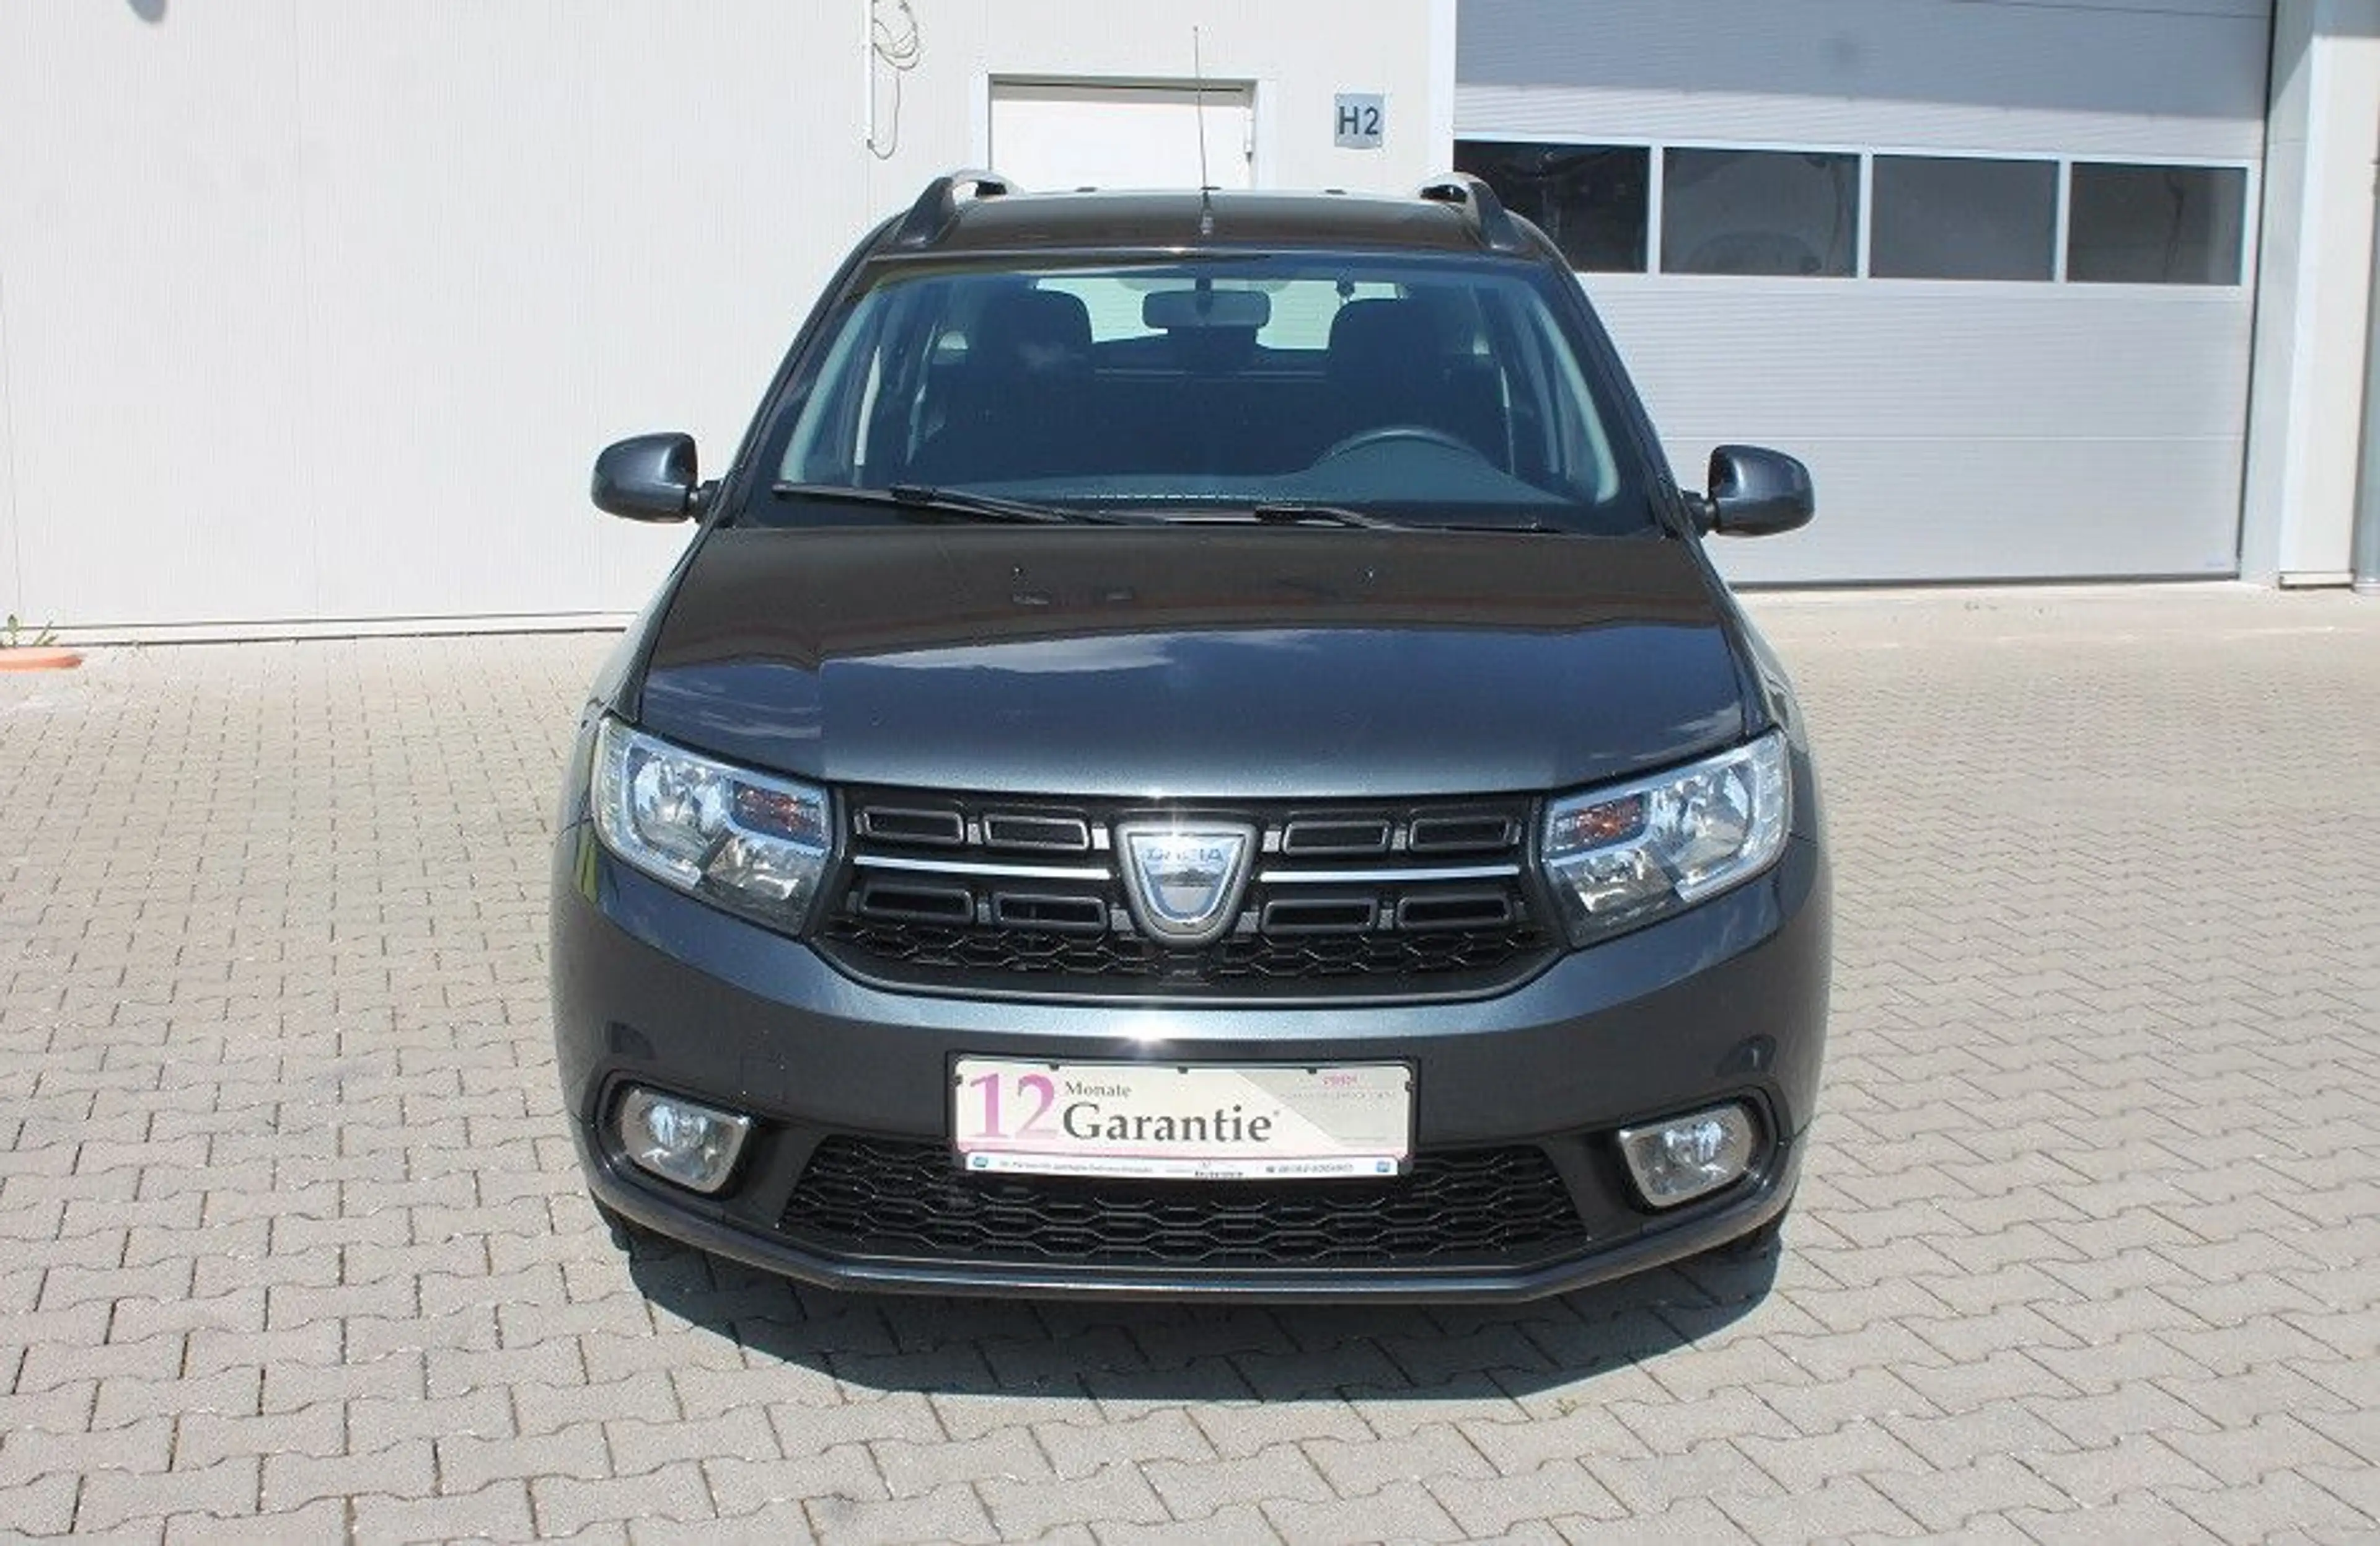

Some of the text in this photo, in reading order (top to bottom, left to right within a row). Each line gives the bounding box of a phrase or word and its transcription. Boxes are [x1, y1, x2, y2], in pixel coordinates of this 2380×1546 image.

[1339, 106, 1378, 135] H2
[1066, 1081, 1132, 1097] Monate
[970, 1073, 1059, 1139] 12
